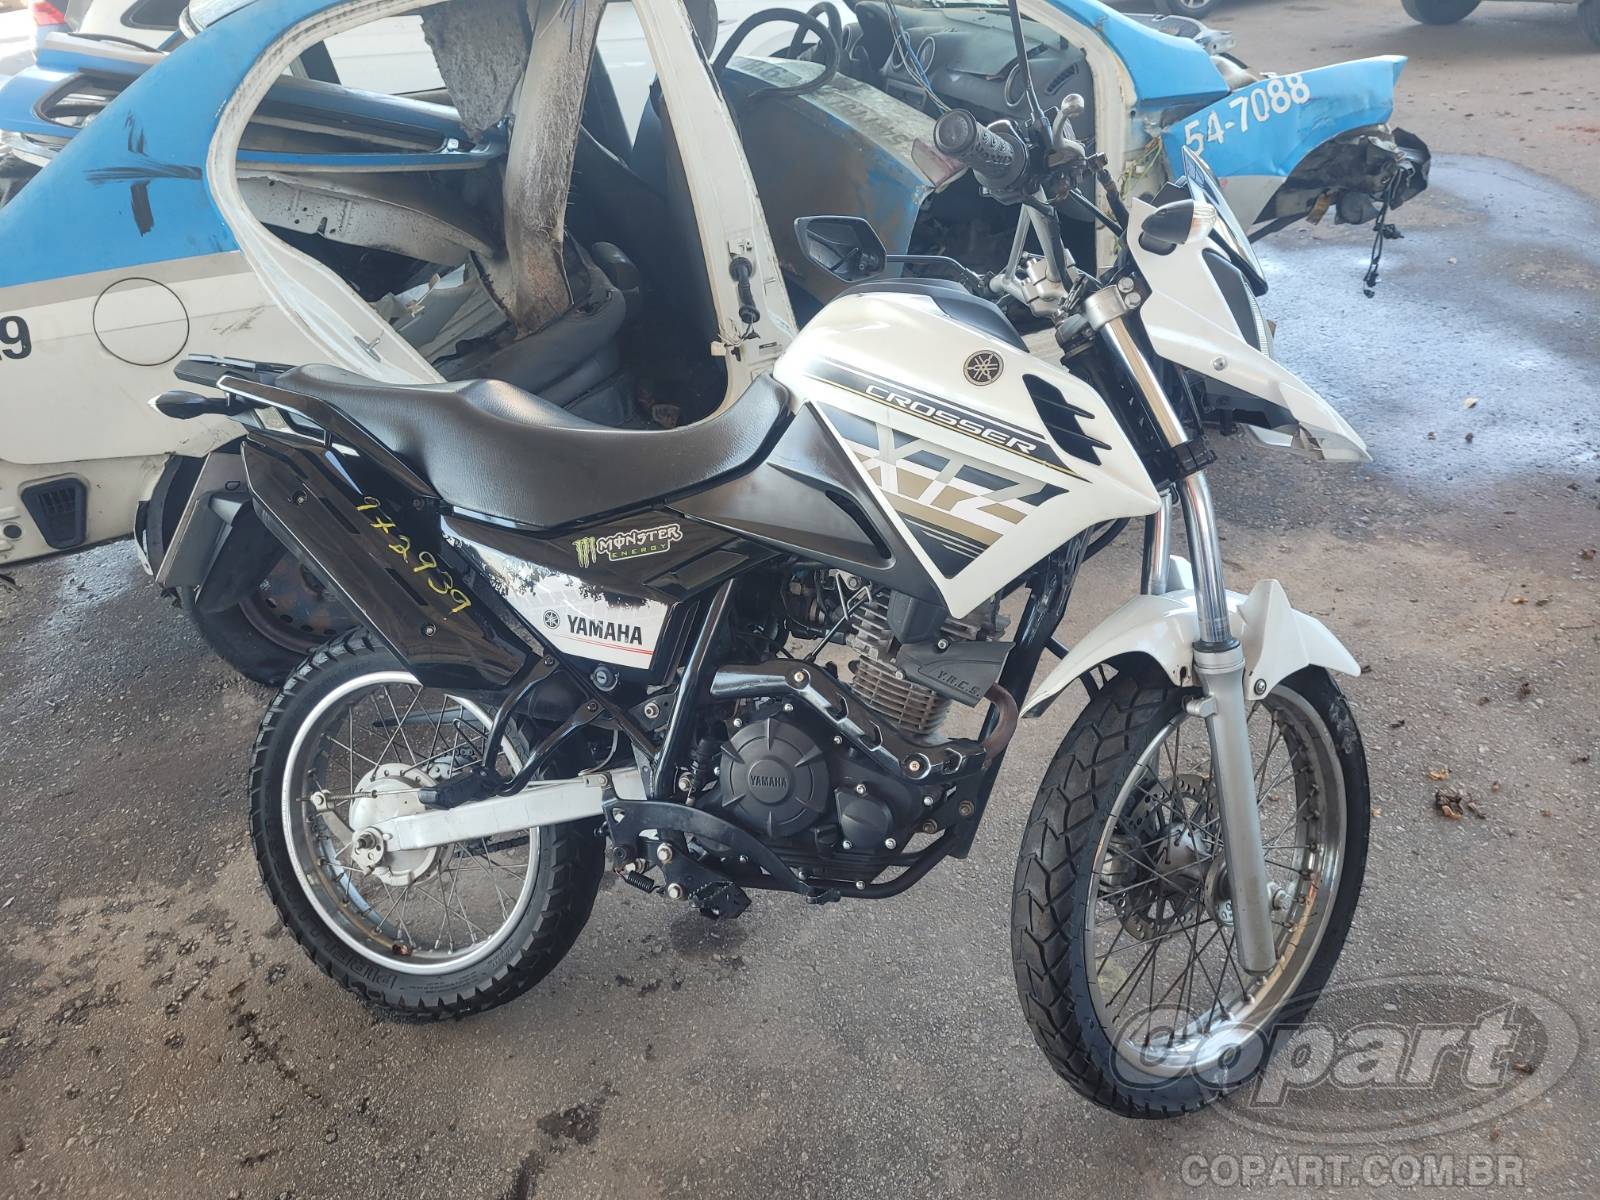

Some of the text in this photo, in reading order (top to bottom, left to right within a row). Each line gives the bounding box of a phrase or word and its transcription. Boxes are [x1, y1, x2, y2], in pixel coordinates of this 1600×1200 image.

[1184, 73, 1311, 158] 54-7088
[865, 384, 1037, 455] CROSSER
[842, 418, 1048, 535] XTZ
[598, 525, 681, 553] MONSTER
[611, 543, 667, 558] ENERGY
[567, 614, 643, 646] YAMAHA
[750, 775, 787, 789] YAMAHA
